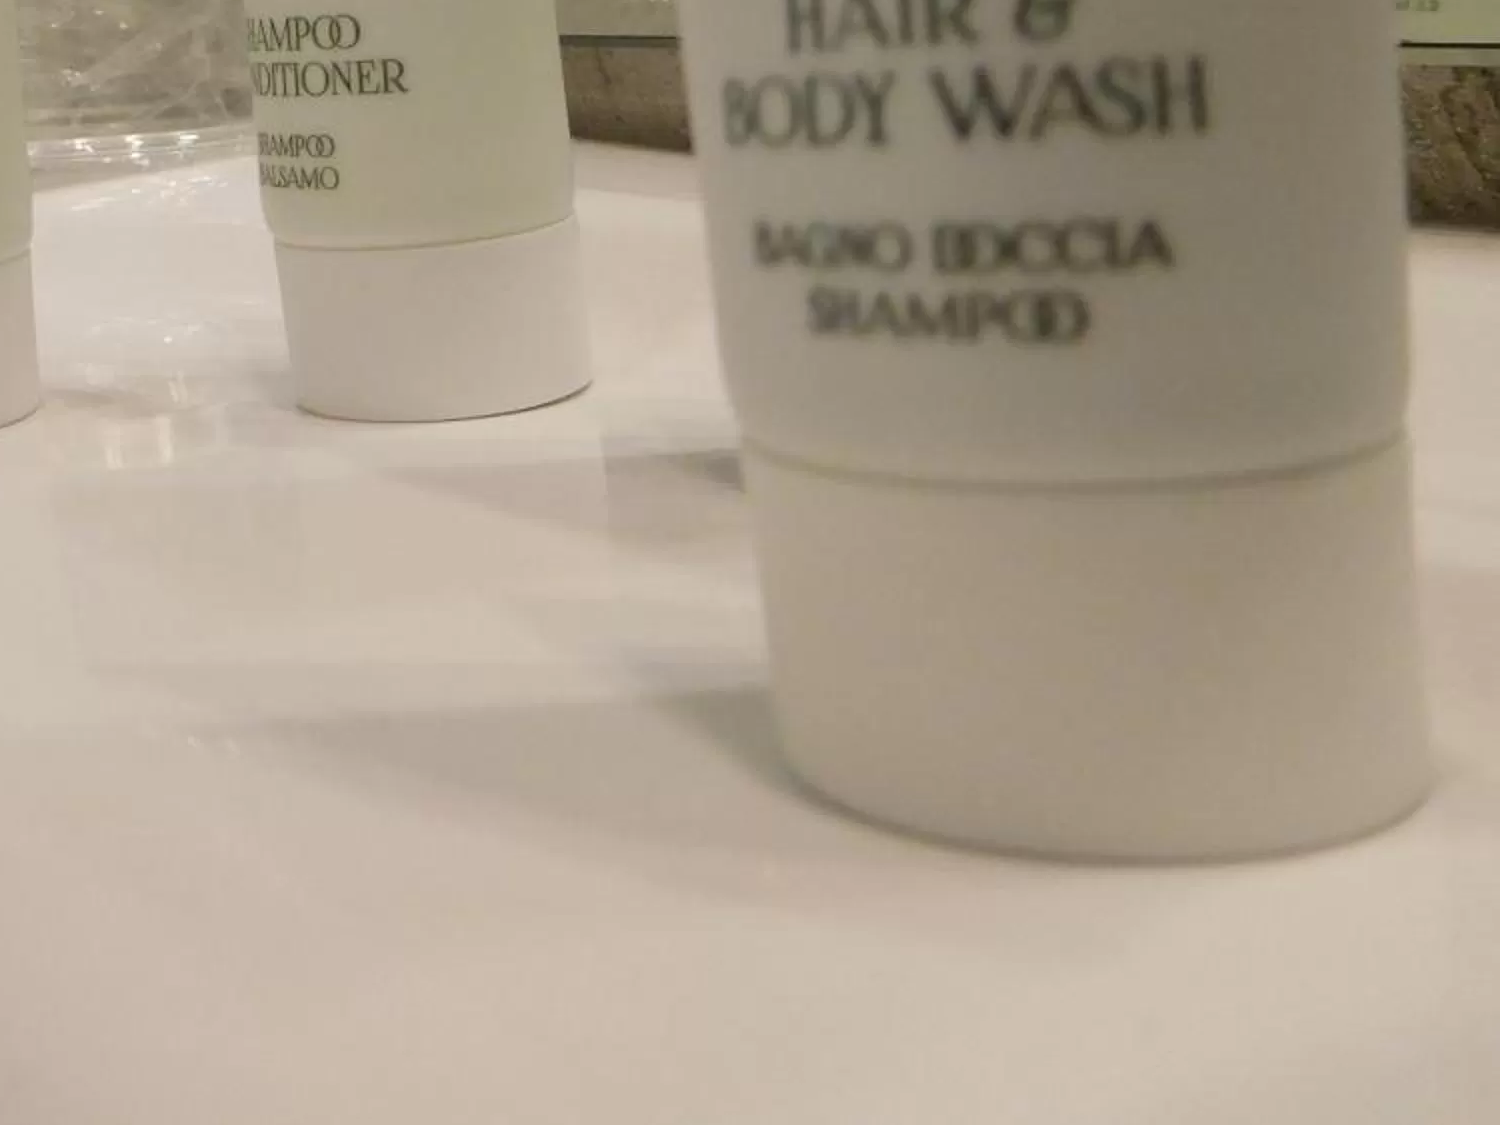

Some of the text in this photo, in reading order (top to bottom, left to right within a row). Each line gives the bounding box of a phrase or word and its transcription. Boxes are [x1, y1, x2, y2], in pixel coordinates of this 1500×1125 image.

[722, 53, 1211, 148] BODY WASH
[806, 284, 1093, 344] SHAMPOO
